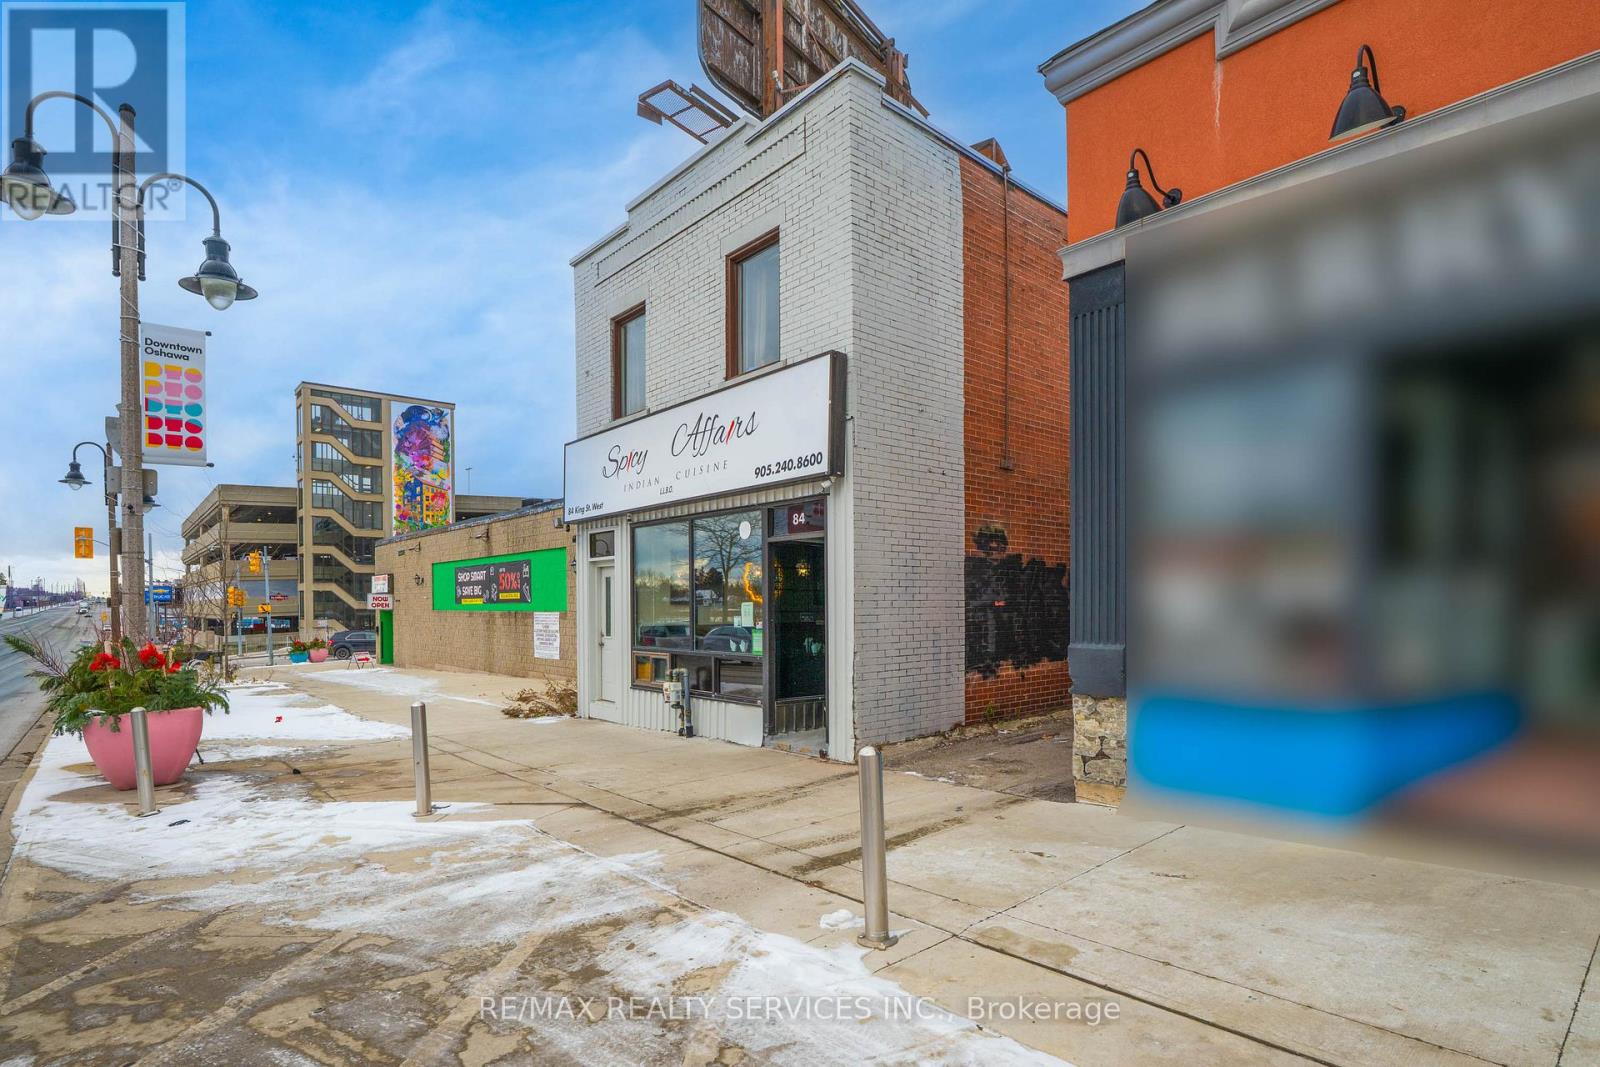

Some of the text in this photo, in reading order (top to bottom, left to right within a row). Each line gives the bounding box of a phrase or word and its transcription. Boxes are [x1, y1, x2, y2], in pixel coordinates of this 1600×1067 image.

[144, 337, 203, 355] Downtown
[144, 347, 190, 361] Oshawa
[602, 411, 759, 479] Spicy Affairs
[754, 451, 823, 479] 905.240.8600
[623, 459, 729, 493] INDIAN CUISINE
[568, 506, 574, 515] 84
[575, 504, 585, 515] King
[592, 502, 603, 510] West
[793, 511, 806, 525] 84
[457, 572, 471, 582] SHOP
[470, 570, 487, 582] SMART
[462, 585, 482, 596] SAVE BIG
